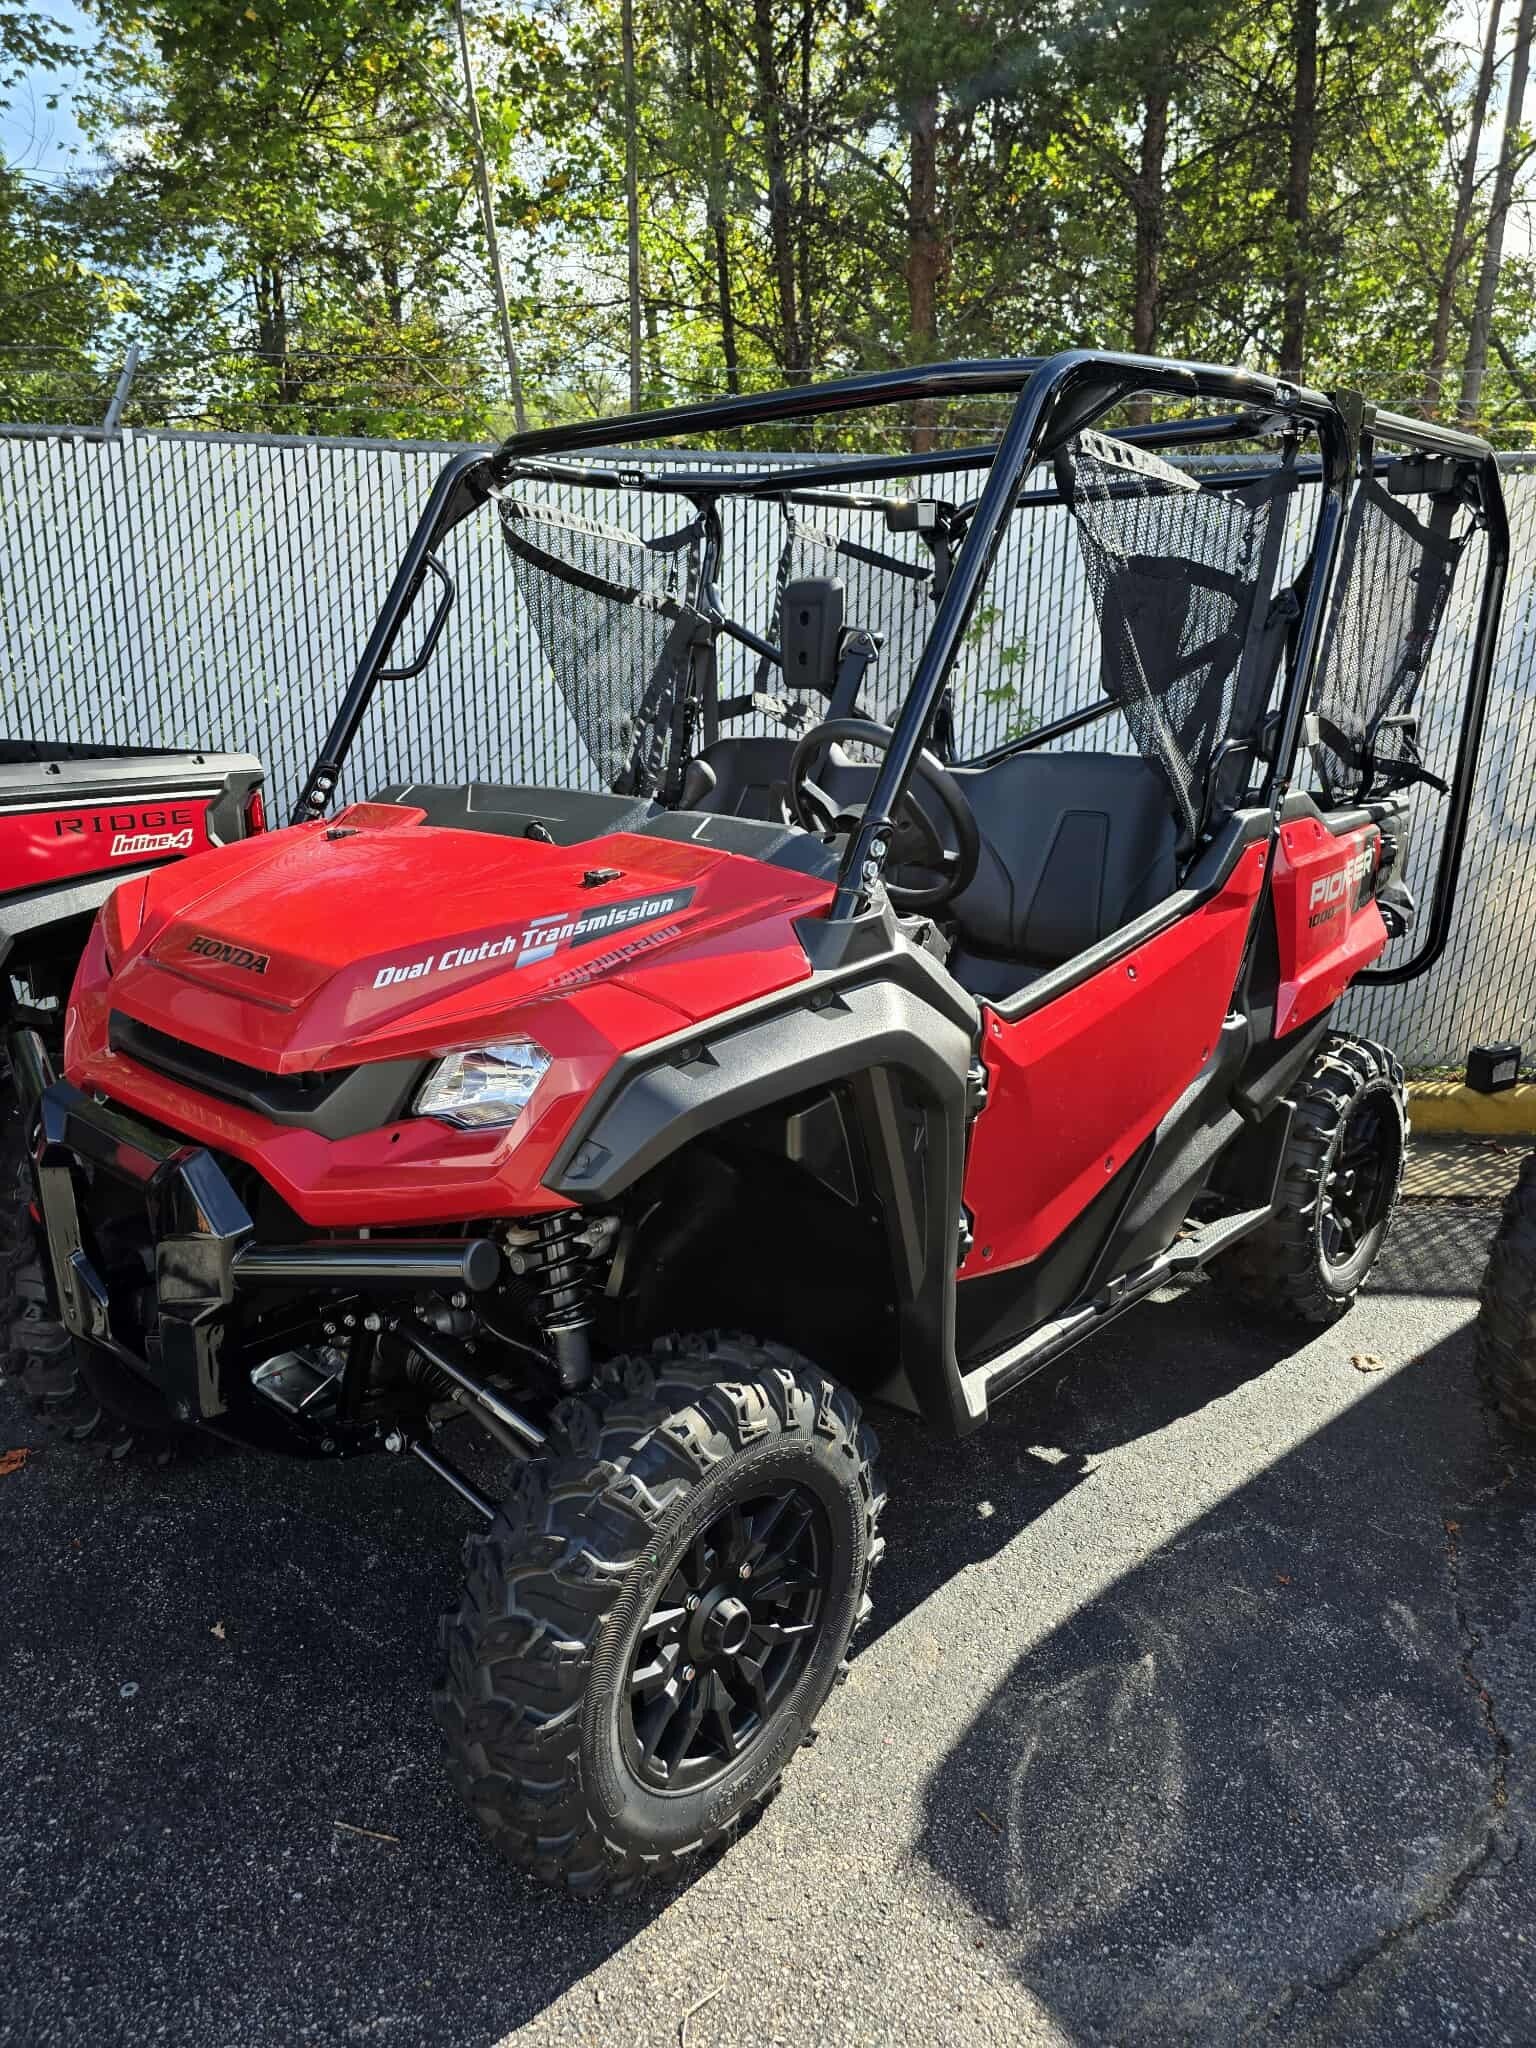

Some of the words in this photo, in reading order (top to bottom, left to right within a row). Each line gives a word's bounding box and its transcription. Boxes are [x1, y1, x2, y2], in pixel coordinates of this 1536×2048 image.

[55, 809, 193, 837] RIDGE
[111, 829, 194, 856] Inline-4
[188, 935, 269, 974] HONDA
[373, 961, 431, 989] Dual
[438, 935, 516, 971] Clutch
[520, 897, 674, 949] Transmission
